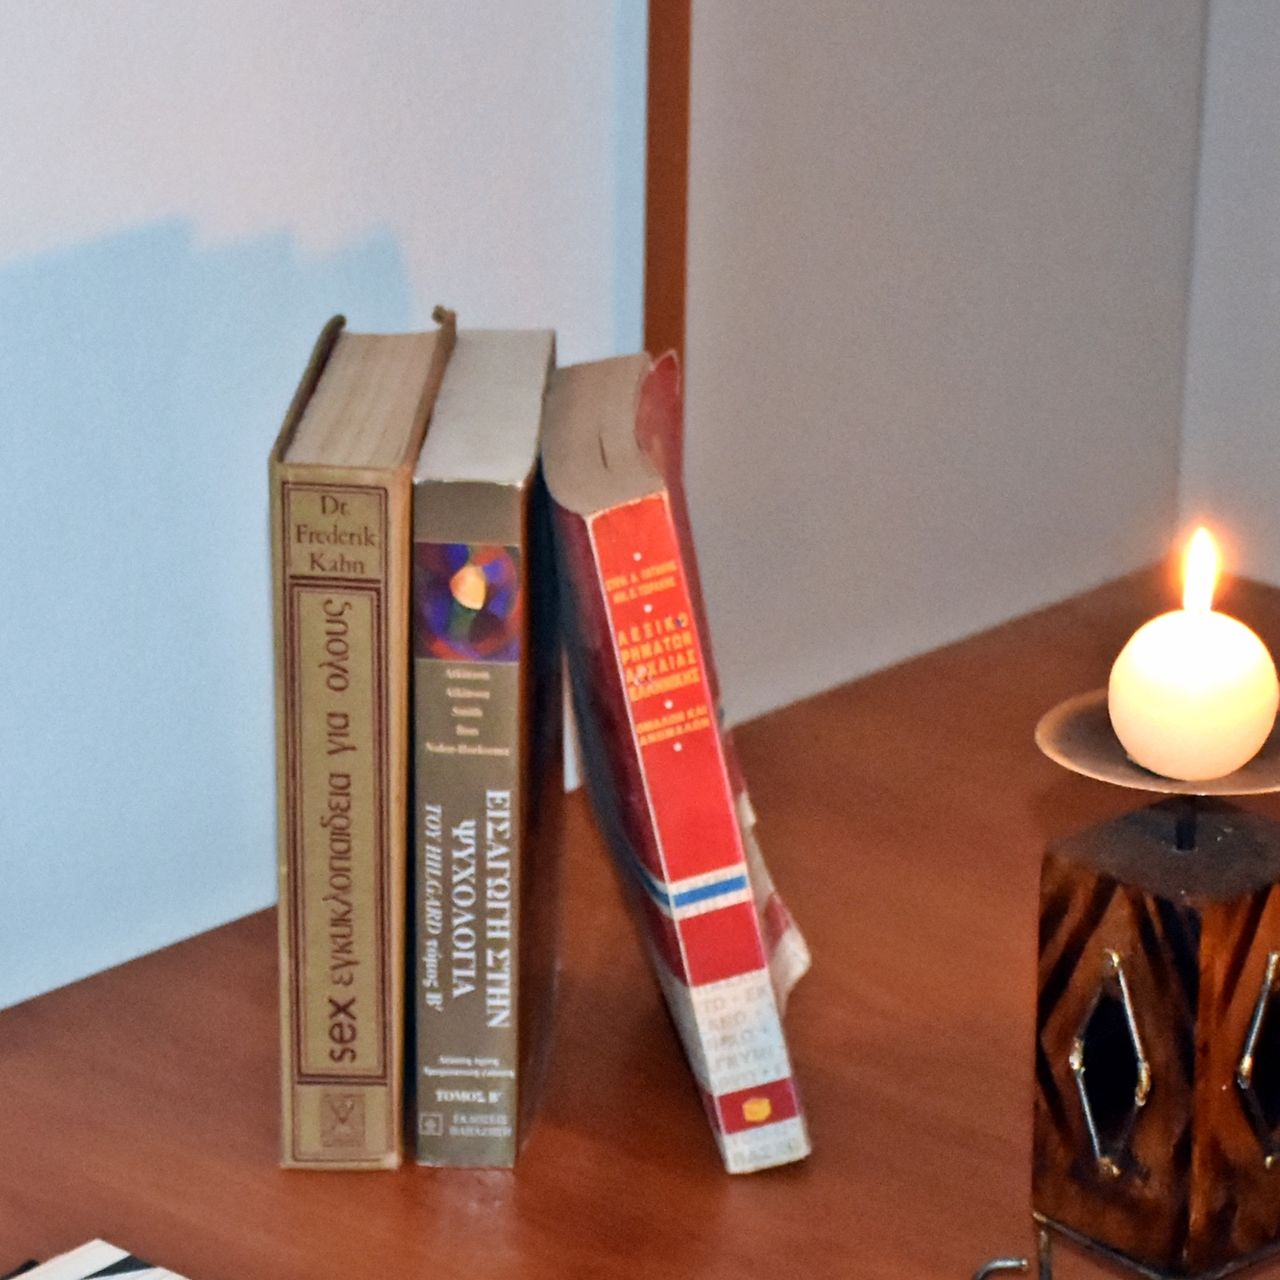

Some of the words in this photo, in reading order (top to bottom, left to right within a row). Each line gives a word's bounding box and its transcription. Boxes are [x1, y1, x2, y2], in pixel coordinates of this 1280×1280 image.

[295, 524, 376, 547] Frederik
[320, 495, 350, 516] Dr.
[309, 552, 365, 574] Kahn
[318, 599, 353, 692] ολους
[327, 711, 358, 755] για
[425, 804, 442, 840] ΤΟΥ
[322, 771, 361, 987] εγκυκλοπαιδεια
[425, 844, 443, 934] HILGARD
[486, 789, 511, 939] ΕΙΣΑΓΩΓΗ
[452, 819, 477, 999] ΨΥΧΟΛΟΓΙΑ
[486, 948, 511, 1028] ΣΤΗΝ
[328, 996, 358, 1064] sex
